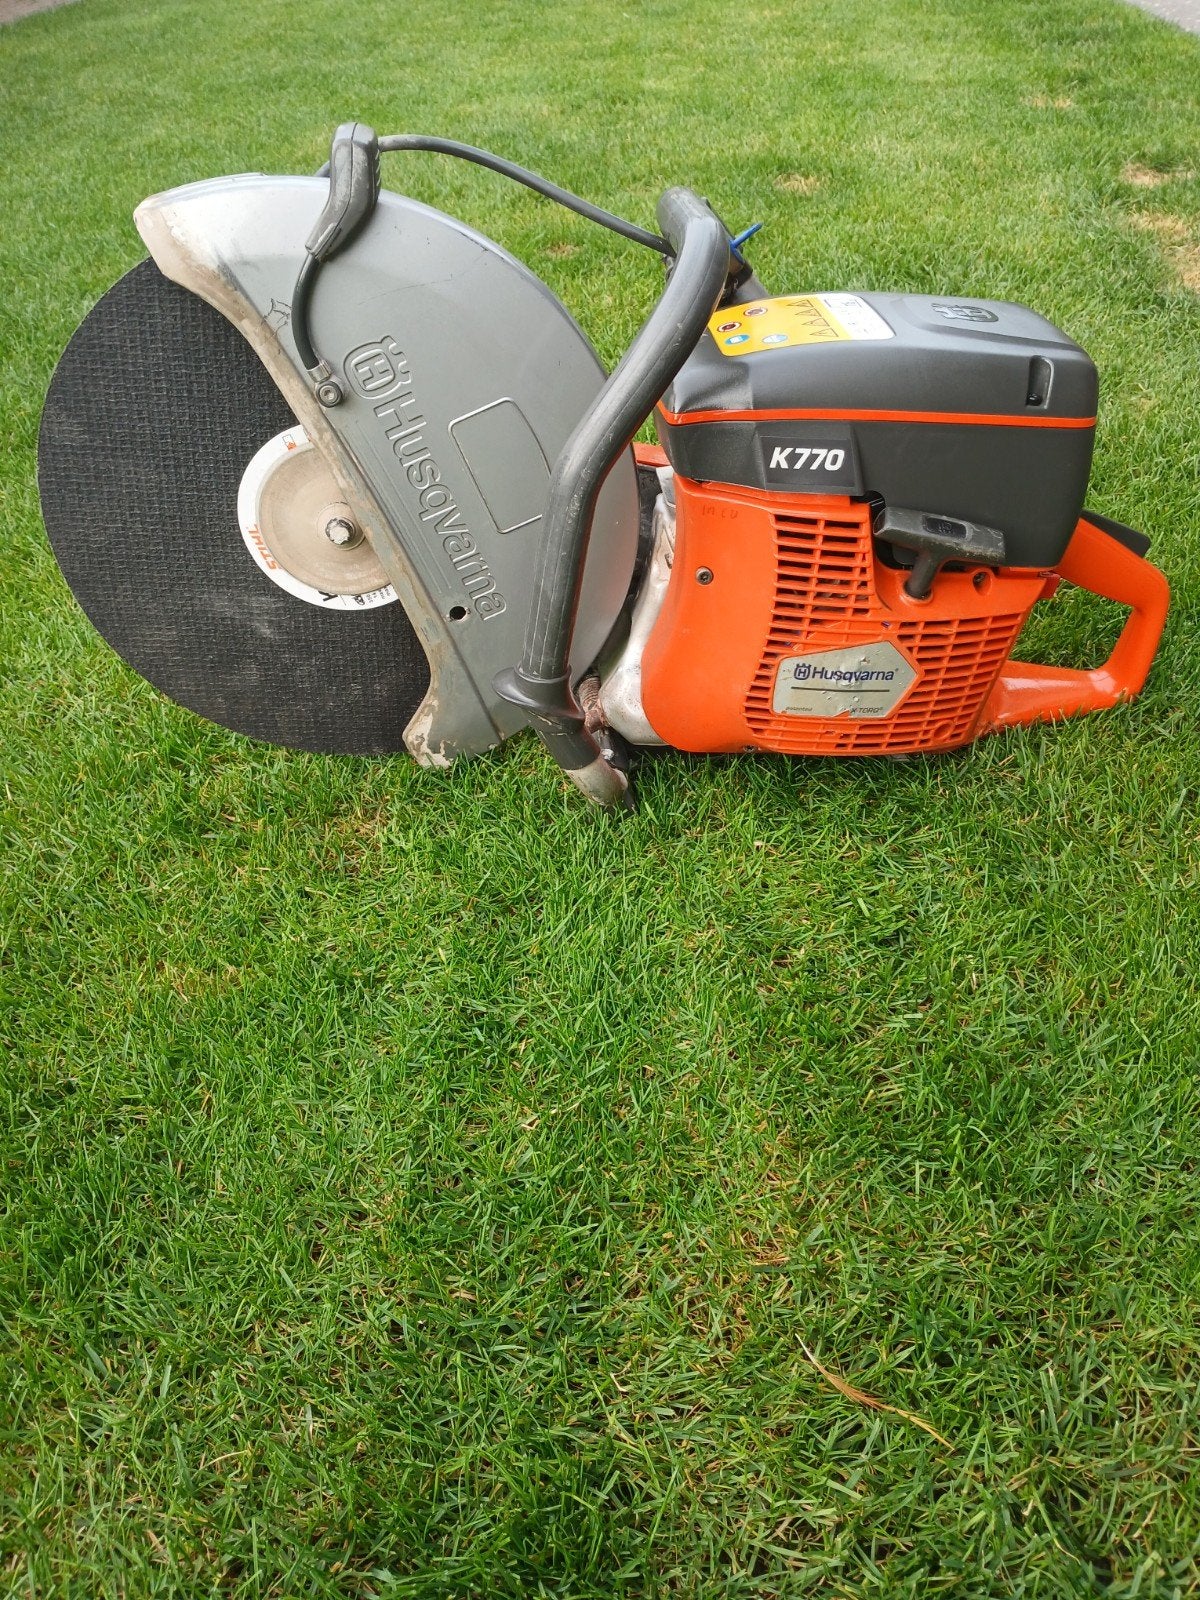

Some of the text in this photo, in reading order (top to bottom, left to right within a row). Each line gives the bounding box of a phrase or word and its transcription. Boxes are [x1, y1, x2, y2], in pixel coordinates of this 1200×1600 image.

[769, 446, 845, 471] K770
[373, 391, 507, 621] Husqvarna
[248, 524, 278, 570] STIHL
[812, 666, 894, 682] Husqvarna
